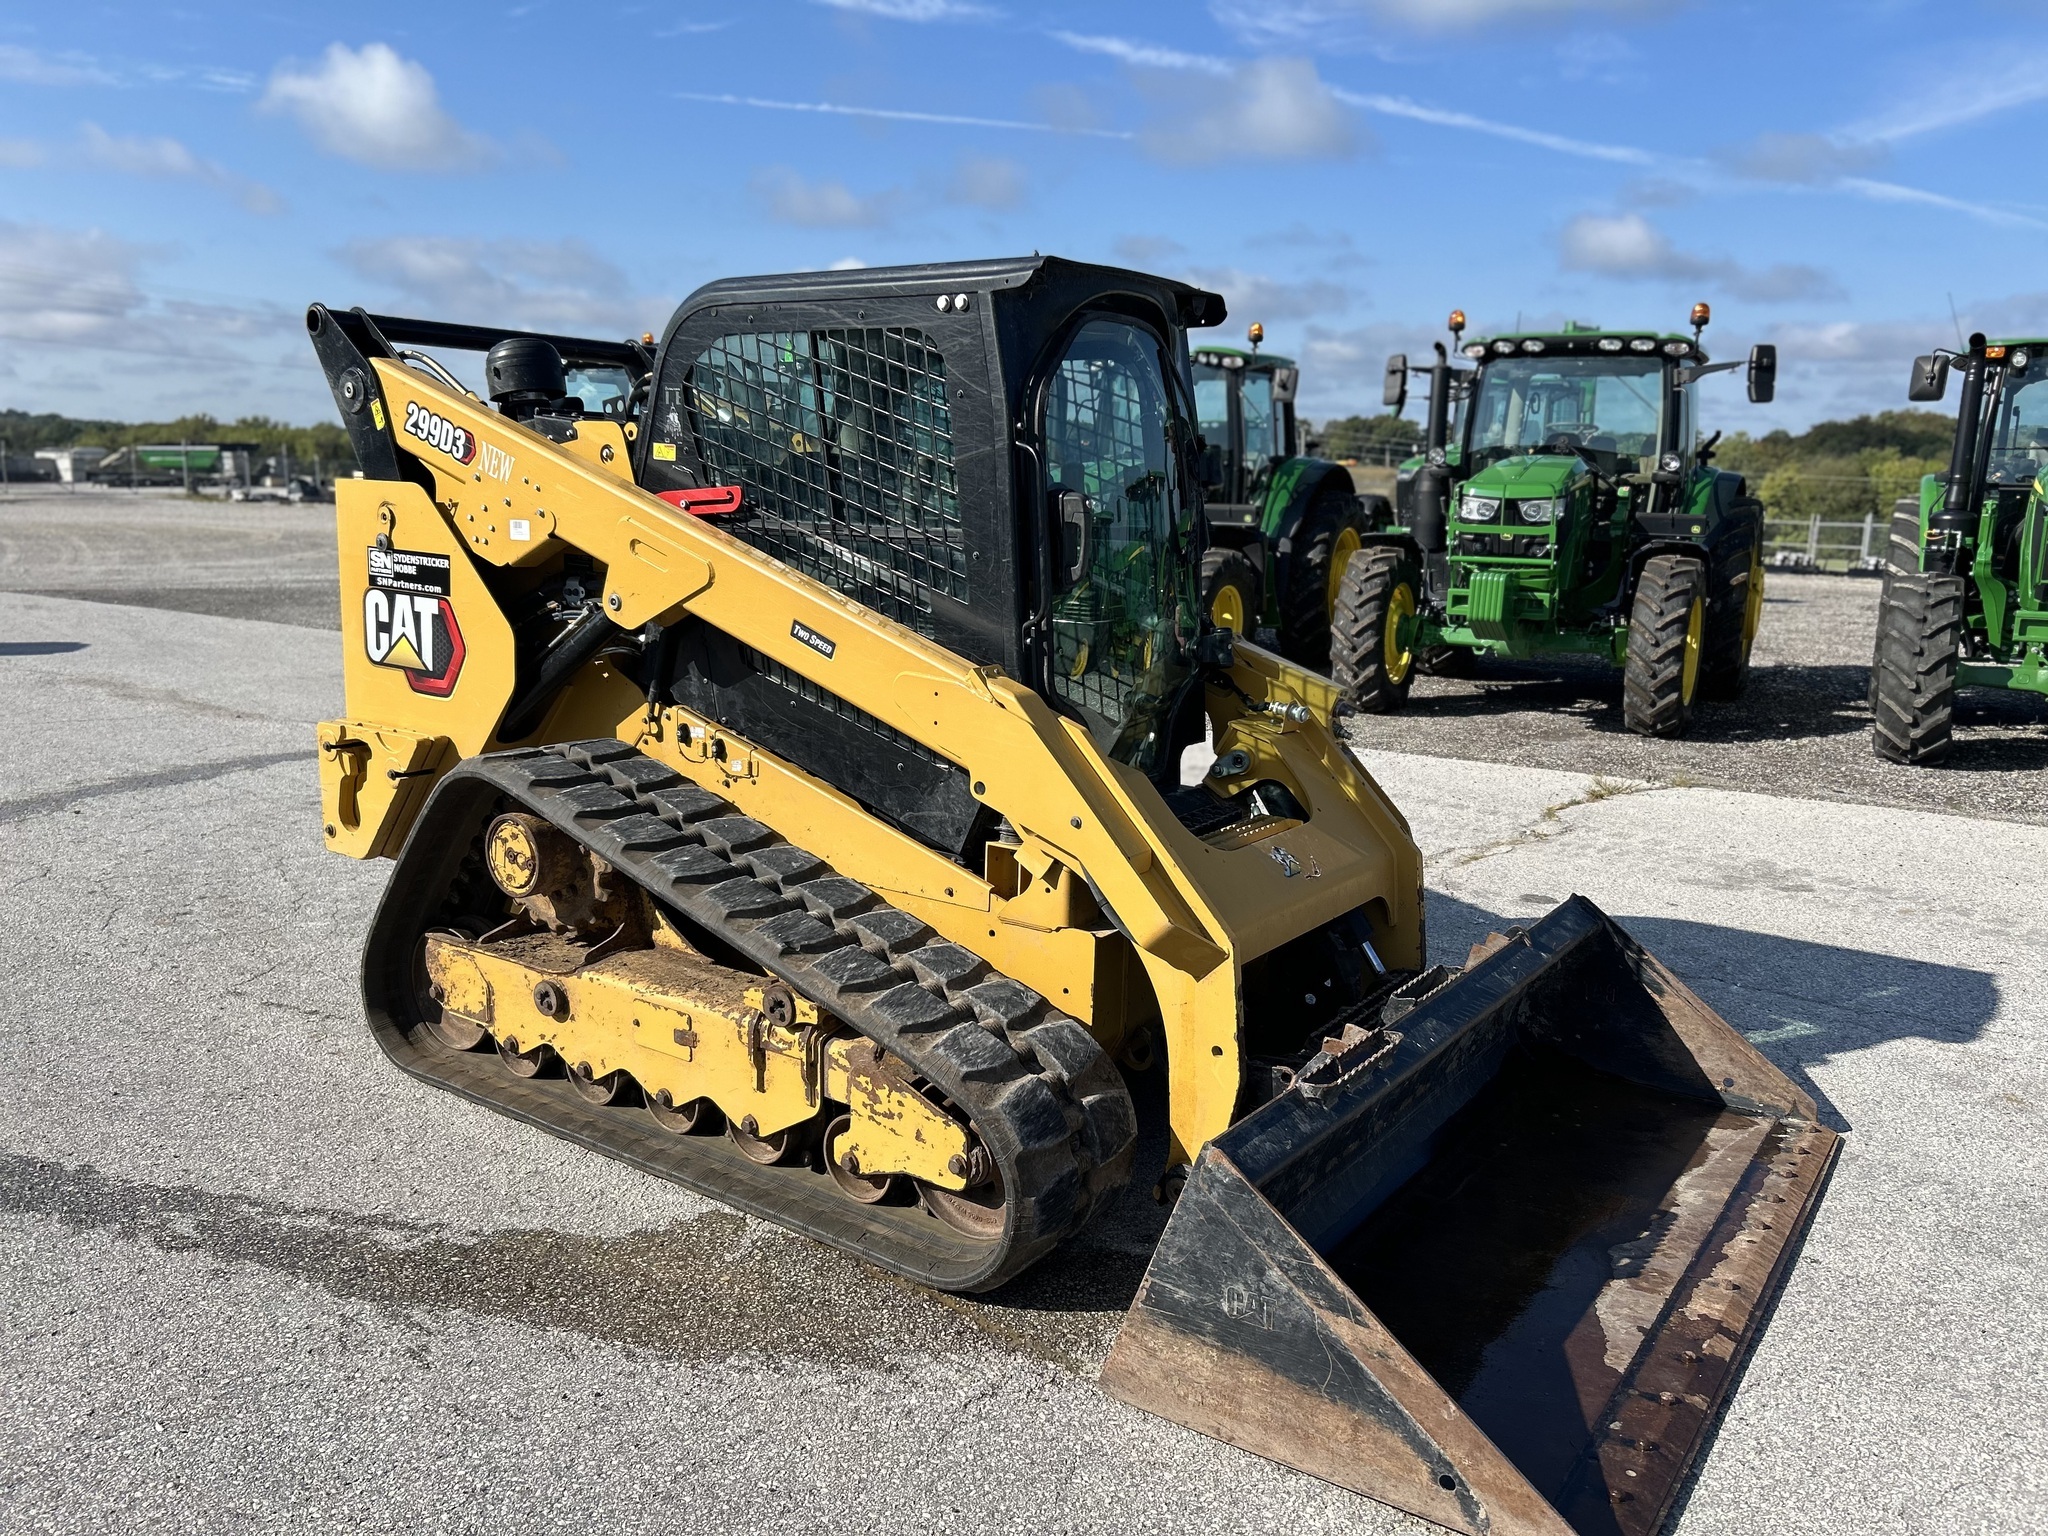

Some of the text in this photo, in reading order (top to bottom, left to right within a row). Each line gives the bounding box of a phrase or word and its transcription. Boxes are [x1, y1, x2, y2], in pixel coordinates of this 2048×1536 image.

[404, 401, 466, 460] 299D3
[477, 441, 516, 484] NEW
[370, 550, 392, 569] SN
[393, 553, 450, 569] SYDENSTRICKER
[393, 563, 417, 575] NOBBE
[376, 576, 442, 594] SNPartners.com
[365, 589, 439, 672] CAT
